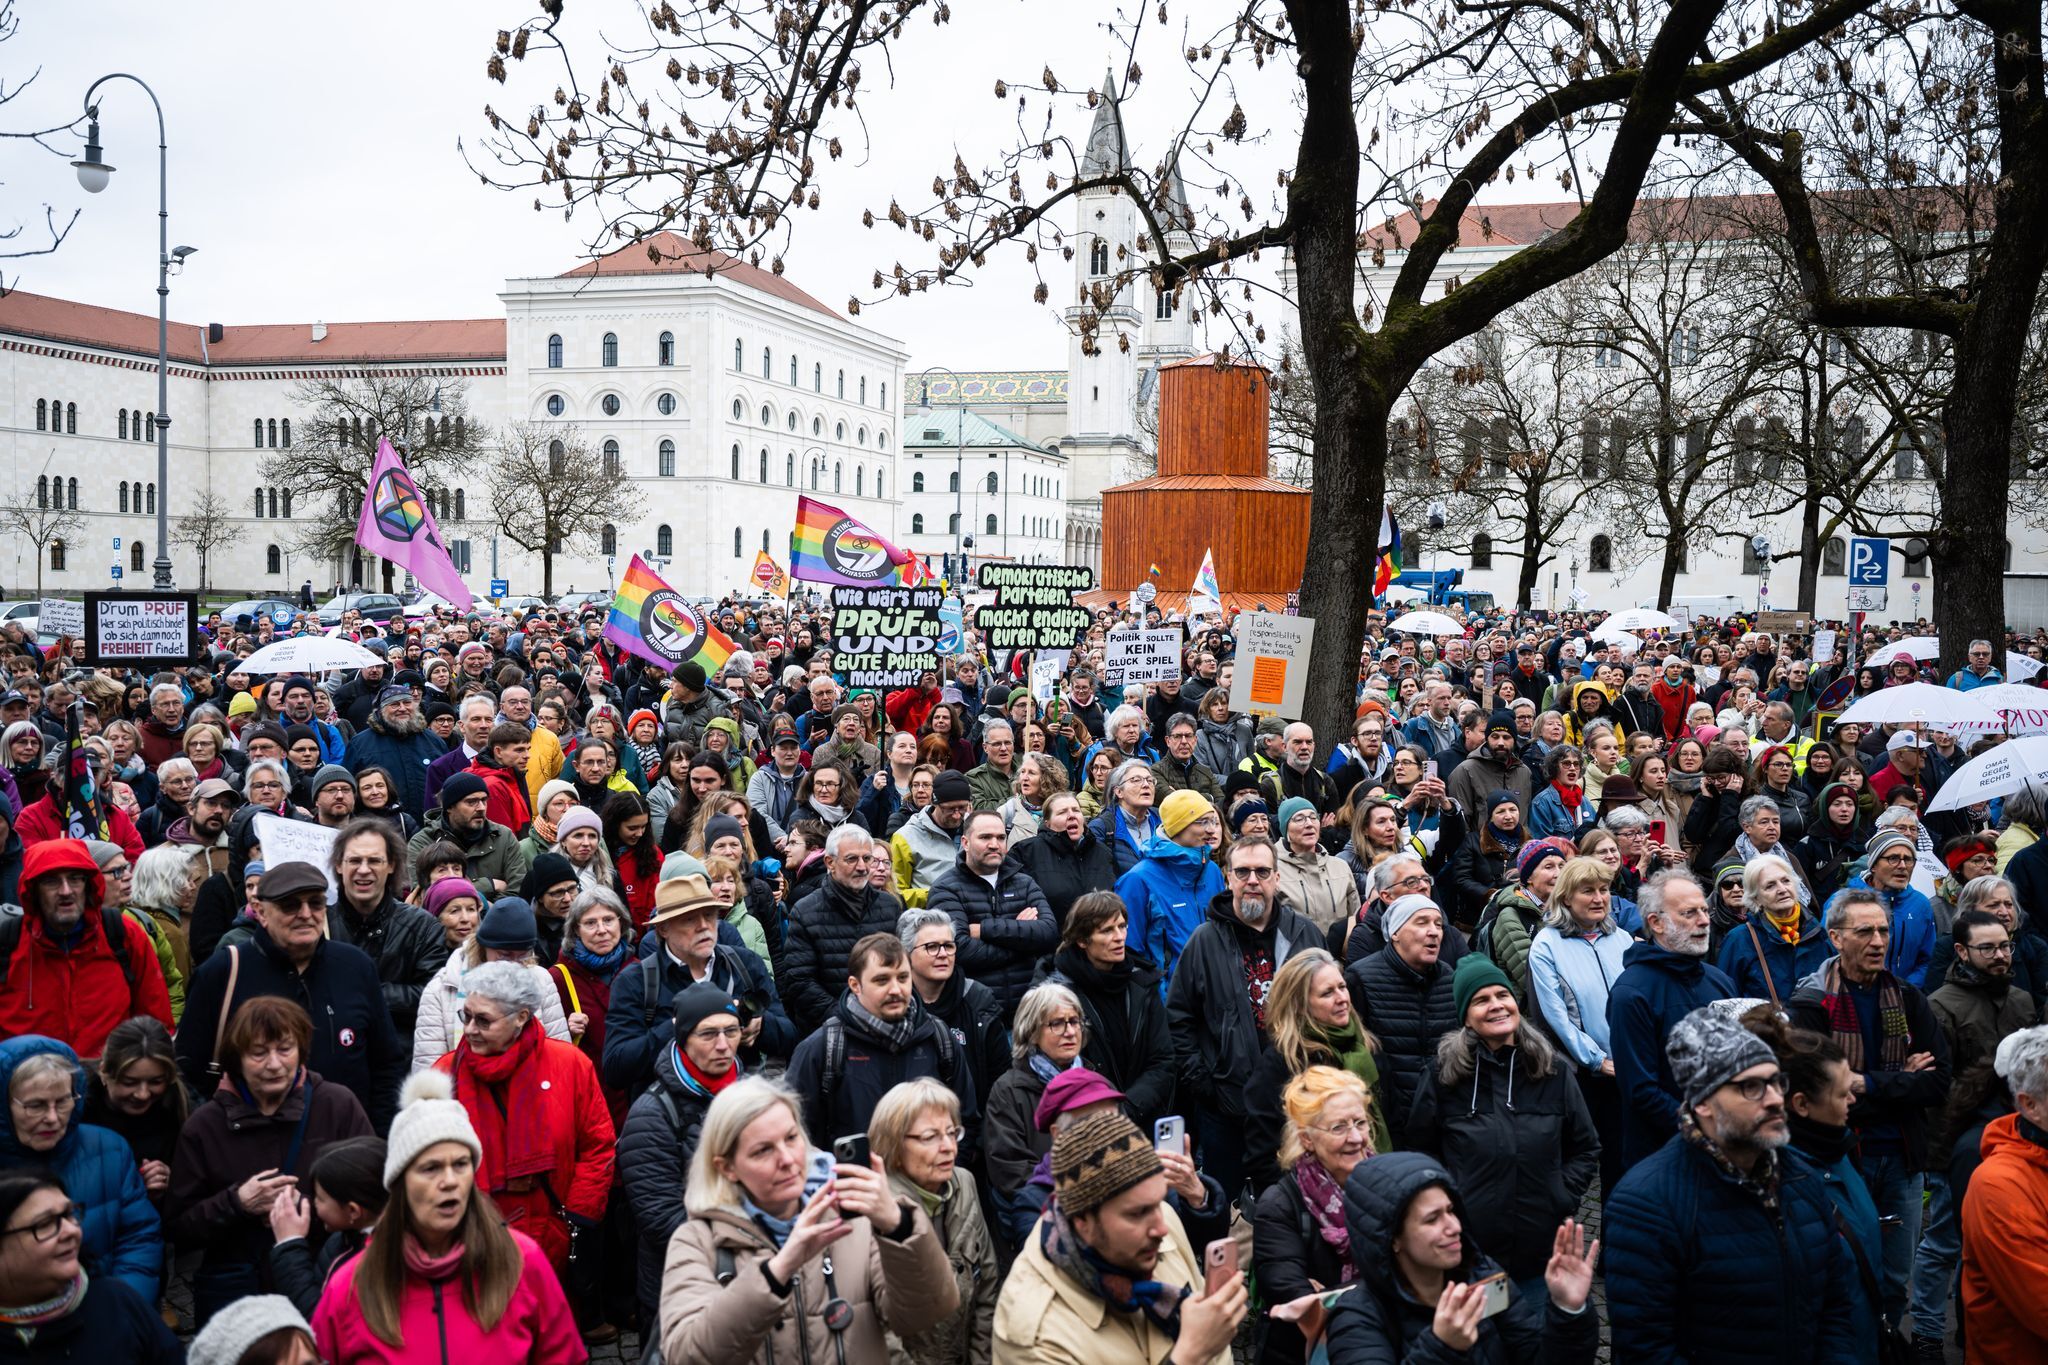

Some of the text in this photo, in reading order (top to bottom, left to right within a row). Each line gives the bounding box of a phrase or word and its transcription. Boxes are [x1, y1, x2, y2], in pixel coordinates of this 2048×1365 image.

[1854, 543, 1873, 578] P
[837, 566, 878, 578] ANTIFASCISTE
[983, 566, 1089, 587] Demokratische
[653, 592, 687, 605] EXTINCTION
[834, 589, 864, 605] Wie
[868, 590, 909, 607] wär's
[914, 590, 942, 606] mit
[1001, 586, 1070, 606] Parteien,
[145, 602, 184, 615] PRÜF
[118, 618, 131, 628] sich
[834, 607, 939, 636] PRÜFen
[980, 609, 1029, 627] macht
[1033, 609, 1089, 628] endlich
[1249, 614, 1273, 628] Take
[105, 630, 117, 640] ob
[120, 631, 138, 640] sich
[992, 628, 1076, 646] euren Job!
[1110, 633, 1140, 642] Politik
[1250, 629, 1301, 643] responsibility
[101, 642, 184, 654] FREIHEIT findet
[646, 634, 681, 659] ANTIFASCISTE
[838, 636, 934, 653] UND
[1126, 644, 1155, 654] KEIN
[1275, 641, 1293, 649] face
[834, 654, 937, 670] GUTE Politik
[1109, 656, 1173, 666] GLÜCK SPIEL
[850, 670, 922, 686] machen?
[1106, 670, 1123, 679] PRÜF
[1129, 671, 1152, 679] SEIN
[1985, 758, 2008, 769] OMAS
[1982, 764, 2009, 778] GEGEN
[1980, 772, 2011, 787] RECHTS
